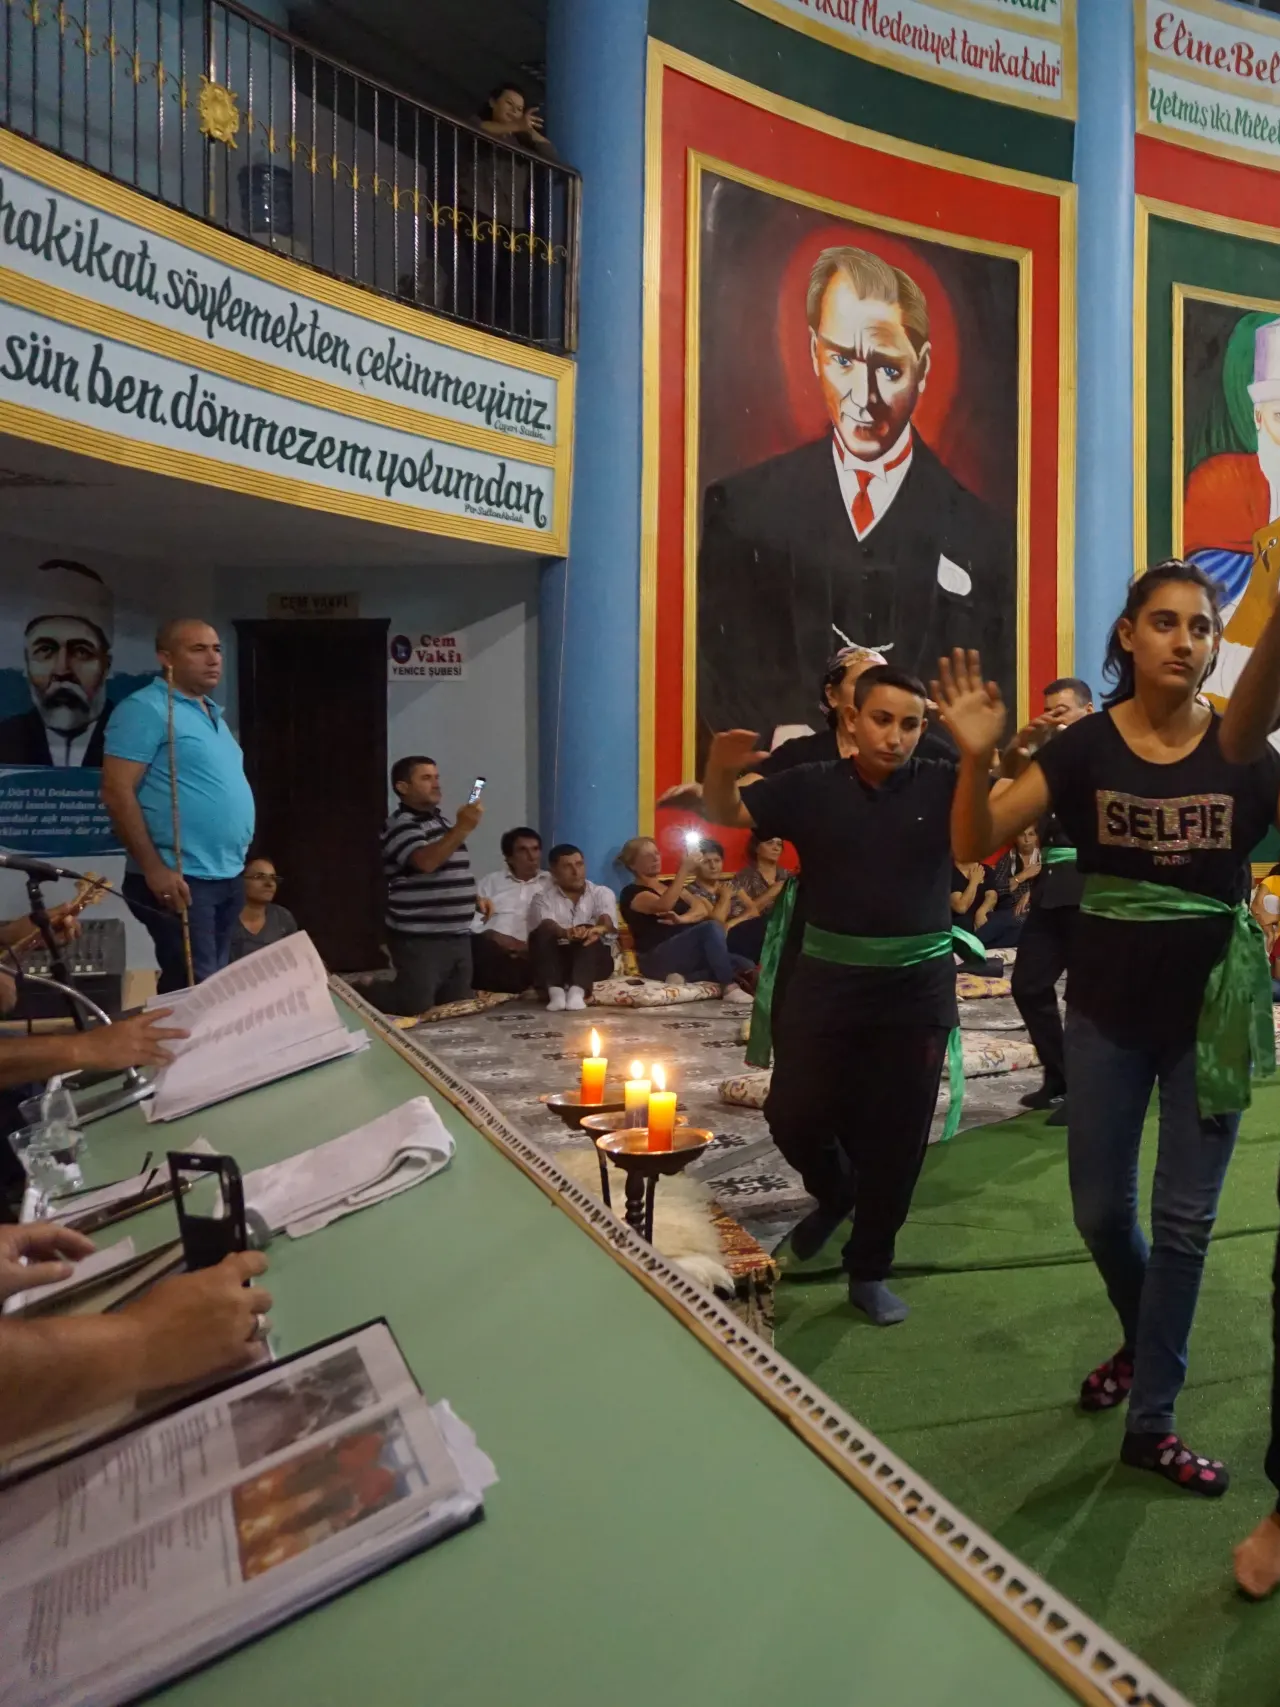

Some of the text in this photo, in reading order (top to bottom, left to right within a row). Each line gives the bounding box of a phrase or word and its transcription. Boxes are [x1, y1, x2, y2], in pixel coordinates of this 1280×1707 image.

[420, 634, 457, 648] Cem
[415, 650, 462, 663] Vakfı
[1106, 801, 1226, 844] SELFIE
